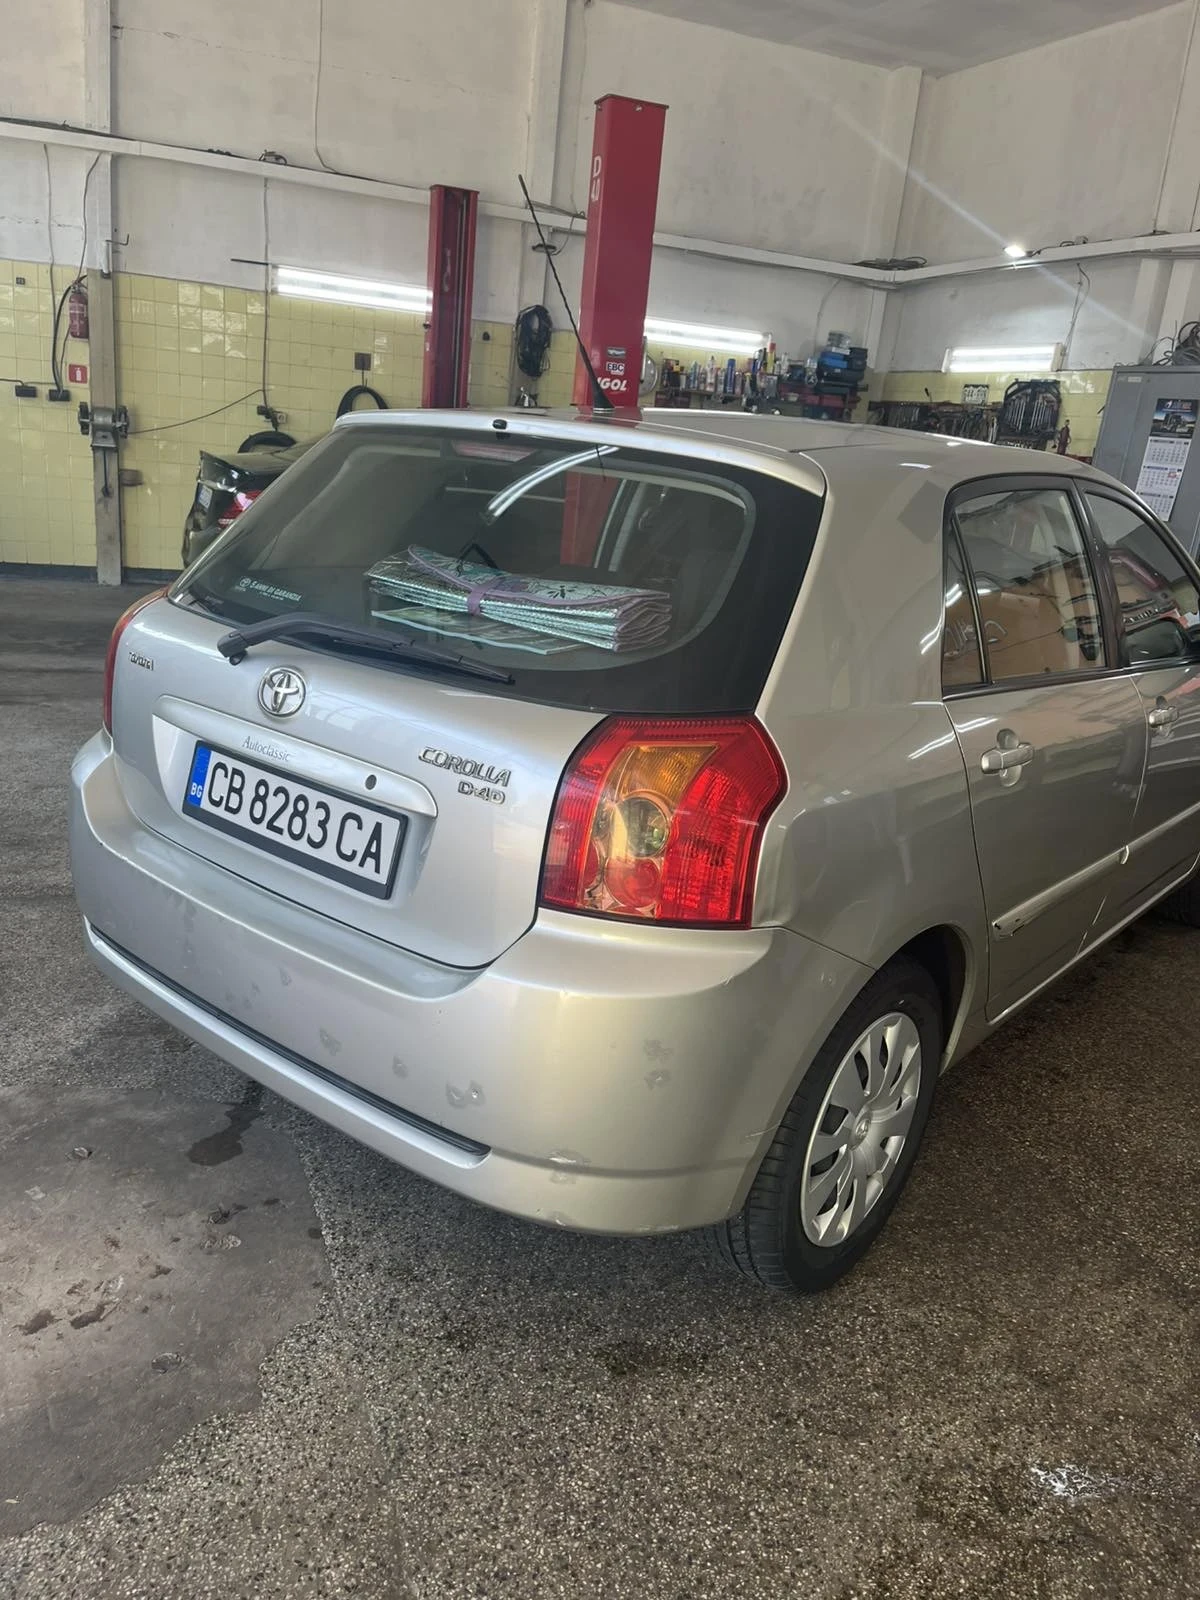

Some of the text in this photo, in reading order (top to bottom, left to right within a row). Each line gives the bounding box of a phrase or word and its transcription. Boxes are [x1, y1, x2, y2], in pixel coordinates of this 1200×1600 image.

[607, 362, 625, 372] EBC
[241, 735, 290, 762] Autoclassic
[418, 746, 512, 788] COROLLA
[191, 782, 203, 799] BG
[457, 780, 506, 805] D-4D
[207, 761, 383, 875] CB 8283 CA
